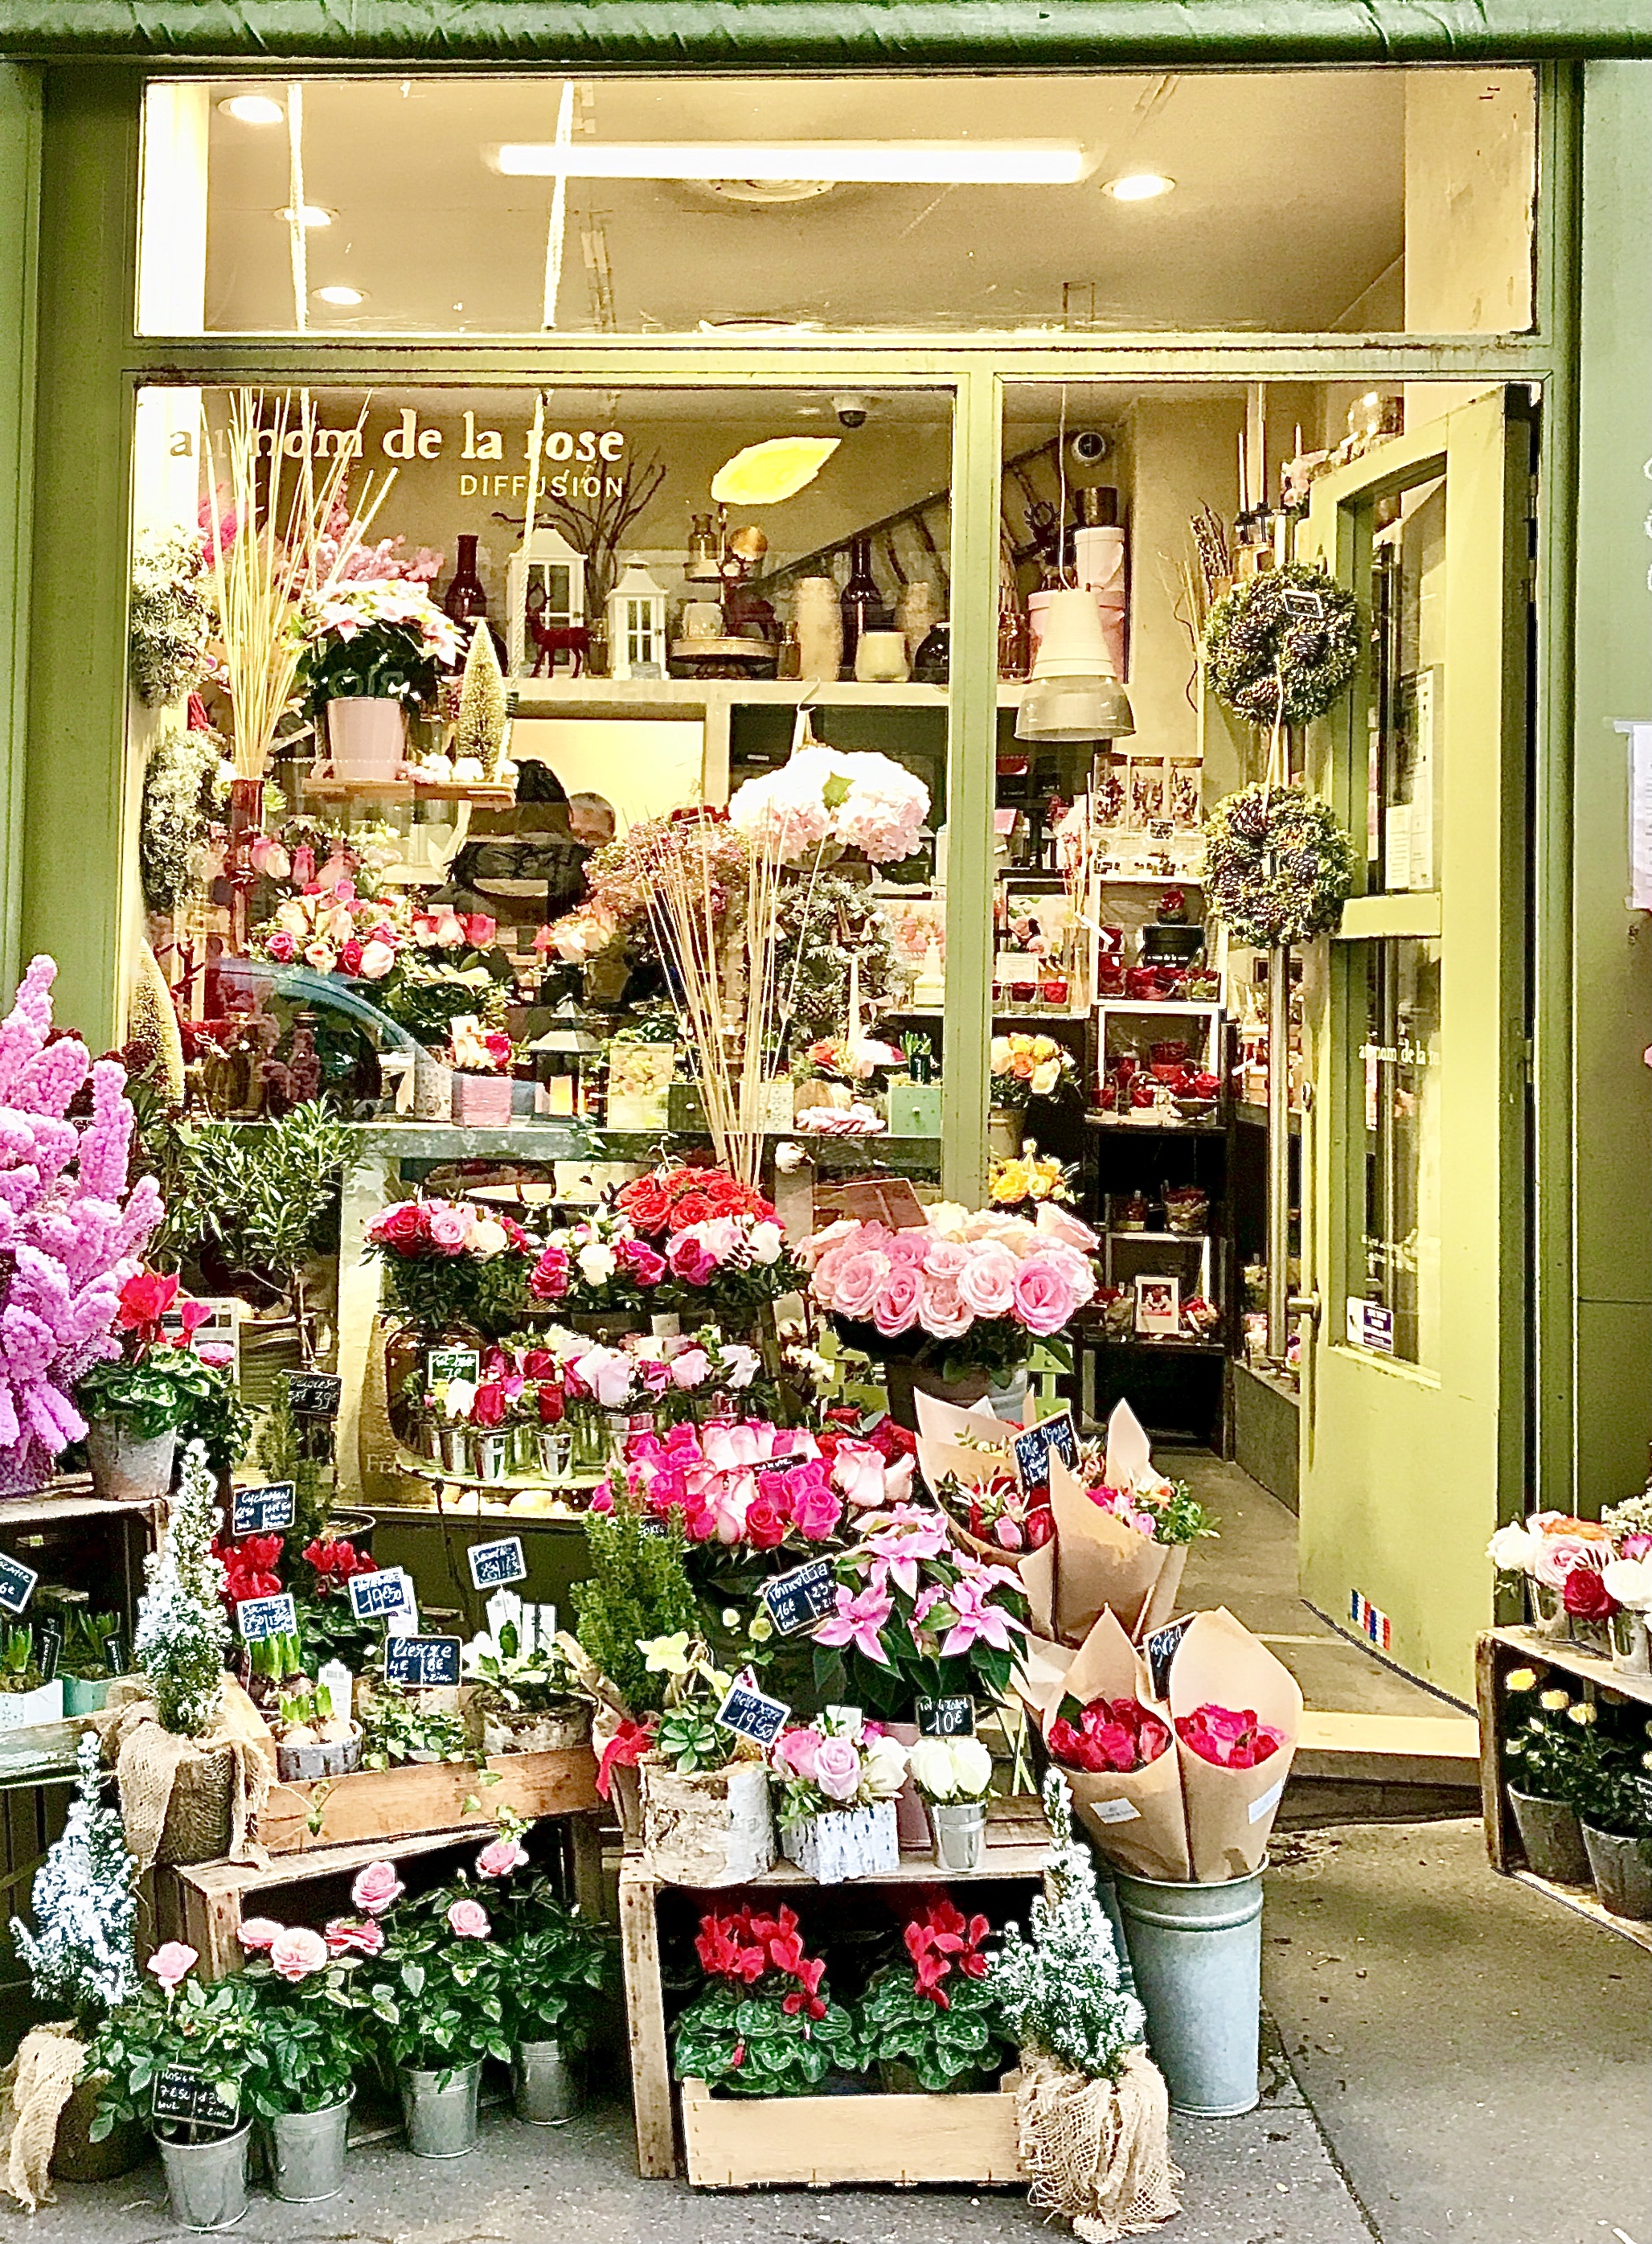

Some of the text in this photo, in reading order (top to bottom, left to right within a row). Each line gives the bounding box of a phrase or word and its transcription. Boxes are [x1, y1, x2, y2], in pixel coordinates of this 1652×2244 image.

[249, 428, 364, 458] nom
[382, 408, 443, 460] de
[461, 410, 502, 460] la
[523, 429, 625, 462] rose
[460, 474, 624, 498] DIFFUSION
[925, 1710, 963, 1735] 10€
